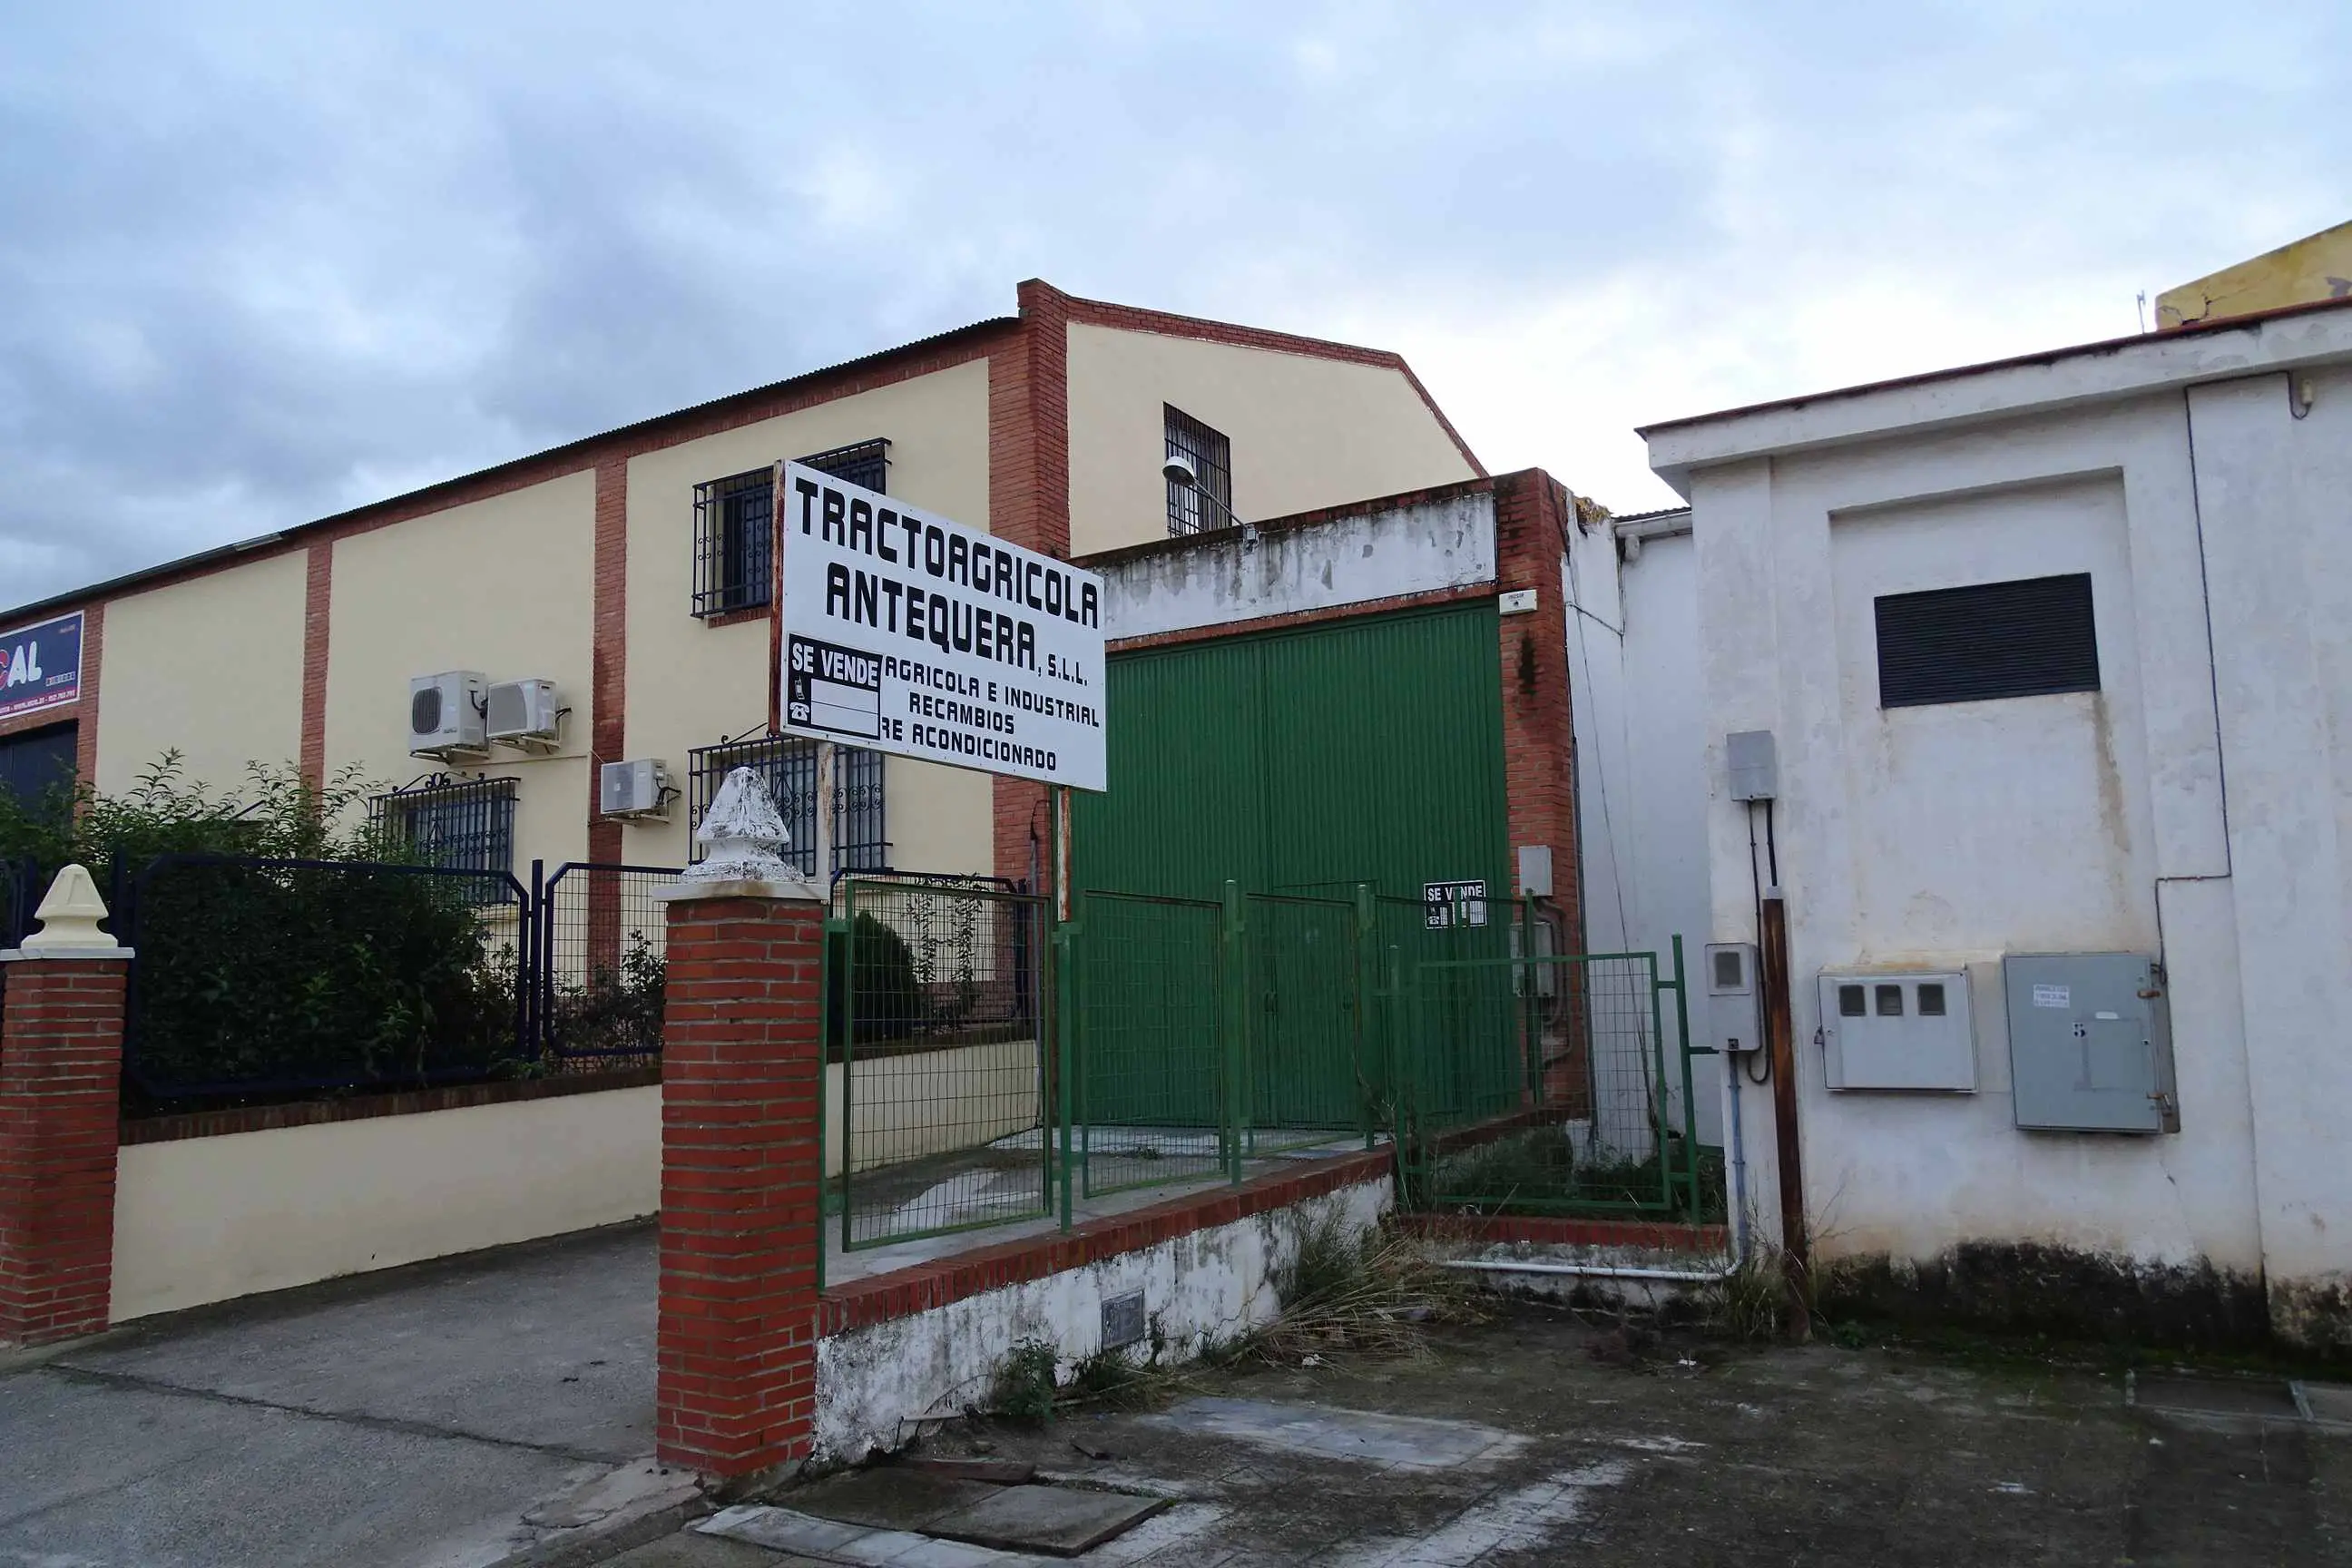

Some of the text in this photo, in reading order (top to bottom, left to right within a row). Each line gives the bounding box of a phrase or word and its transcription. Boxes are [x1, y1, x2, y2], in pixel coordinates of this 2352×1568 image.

[796, 476, 1098, 629] TRACTOAGRICOLA
[792, 642, 878, 687] SE VENDE
[885, 656, 1100, 728] AGRICOLA E INDUSTRIAL
[909, 691, 1014, 734] RECAMBIOS
[912, 723, 1056, 770] ACONDICIONADO
[1427, 885, 1483, 902] SE VNDE
